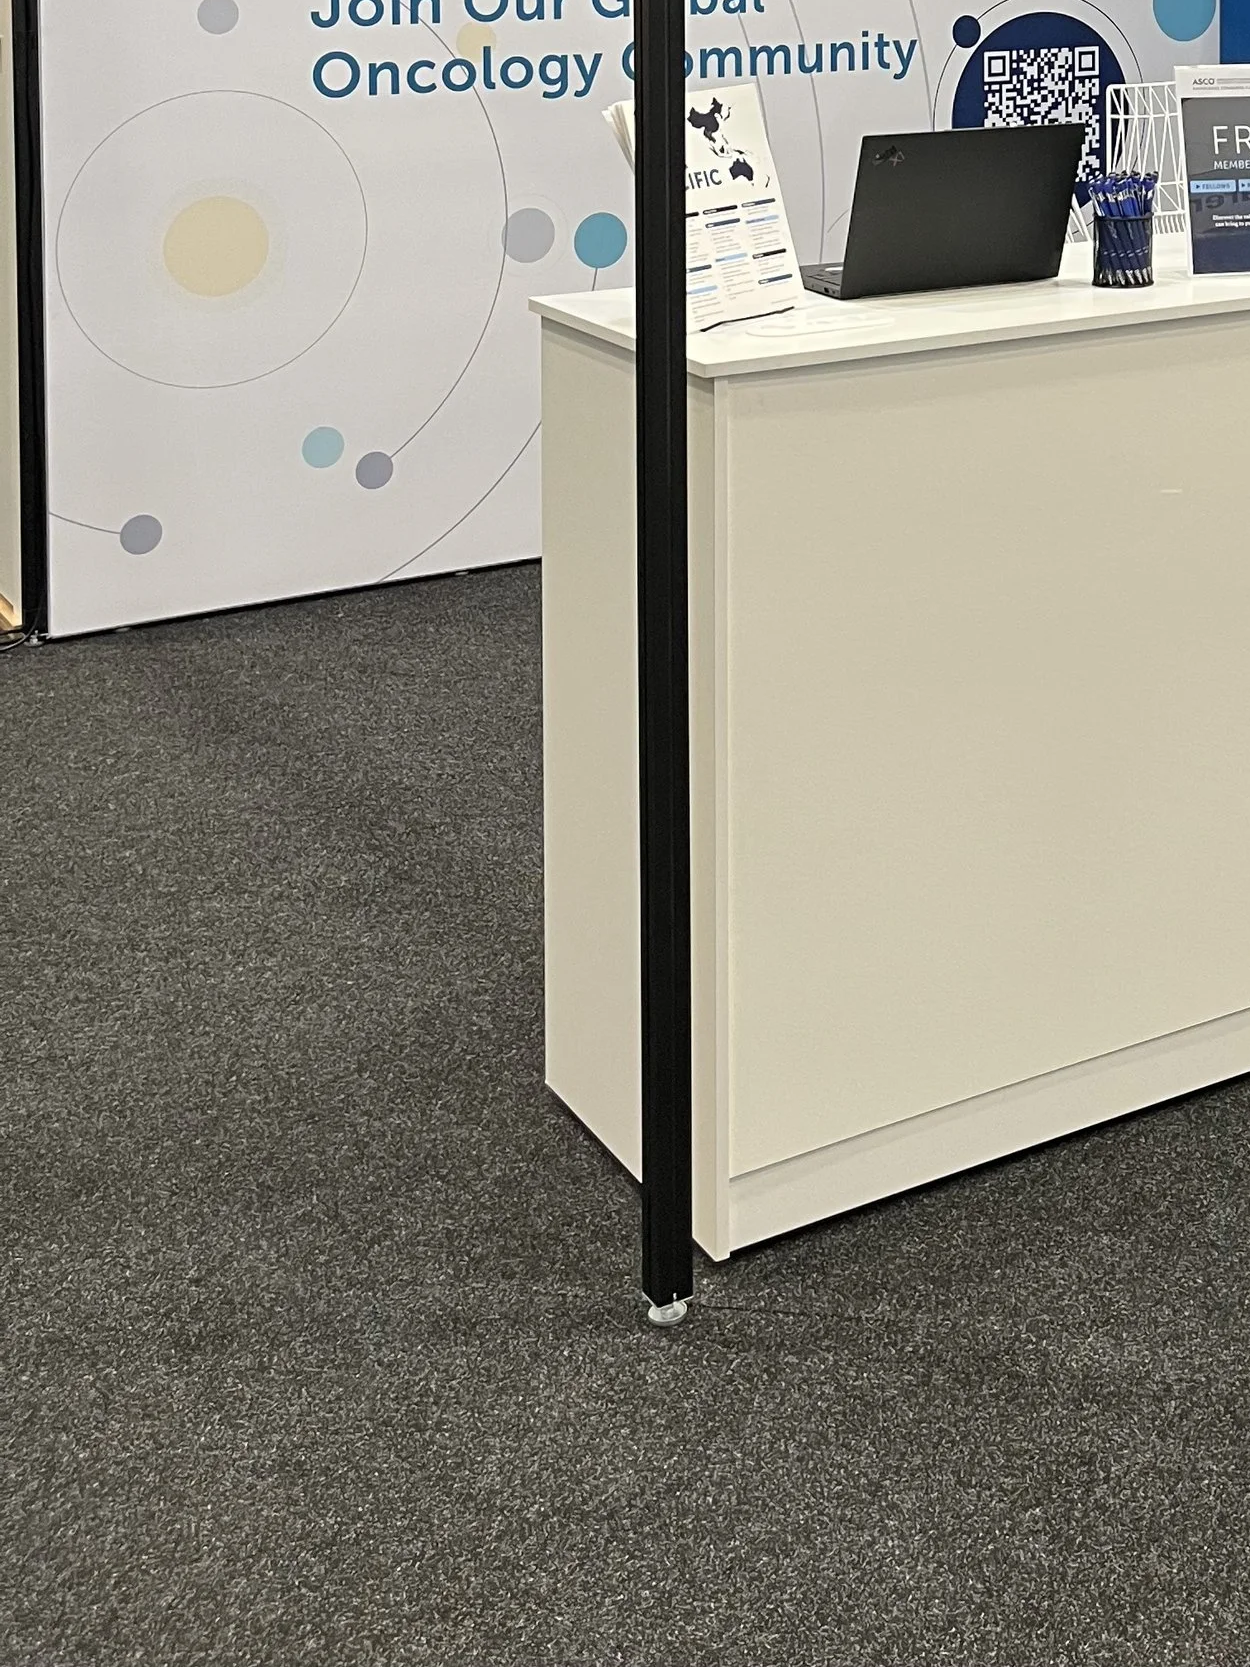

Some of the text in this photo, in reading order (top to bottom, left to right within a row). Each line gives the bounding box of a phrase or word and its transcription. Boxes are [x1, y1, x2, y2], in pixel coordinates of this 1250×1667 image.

[312, 31, 917, 100] Oncology mmunity
[686, 169, 723, 191] IFIC
